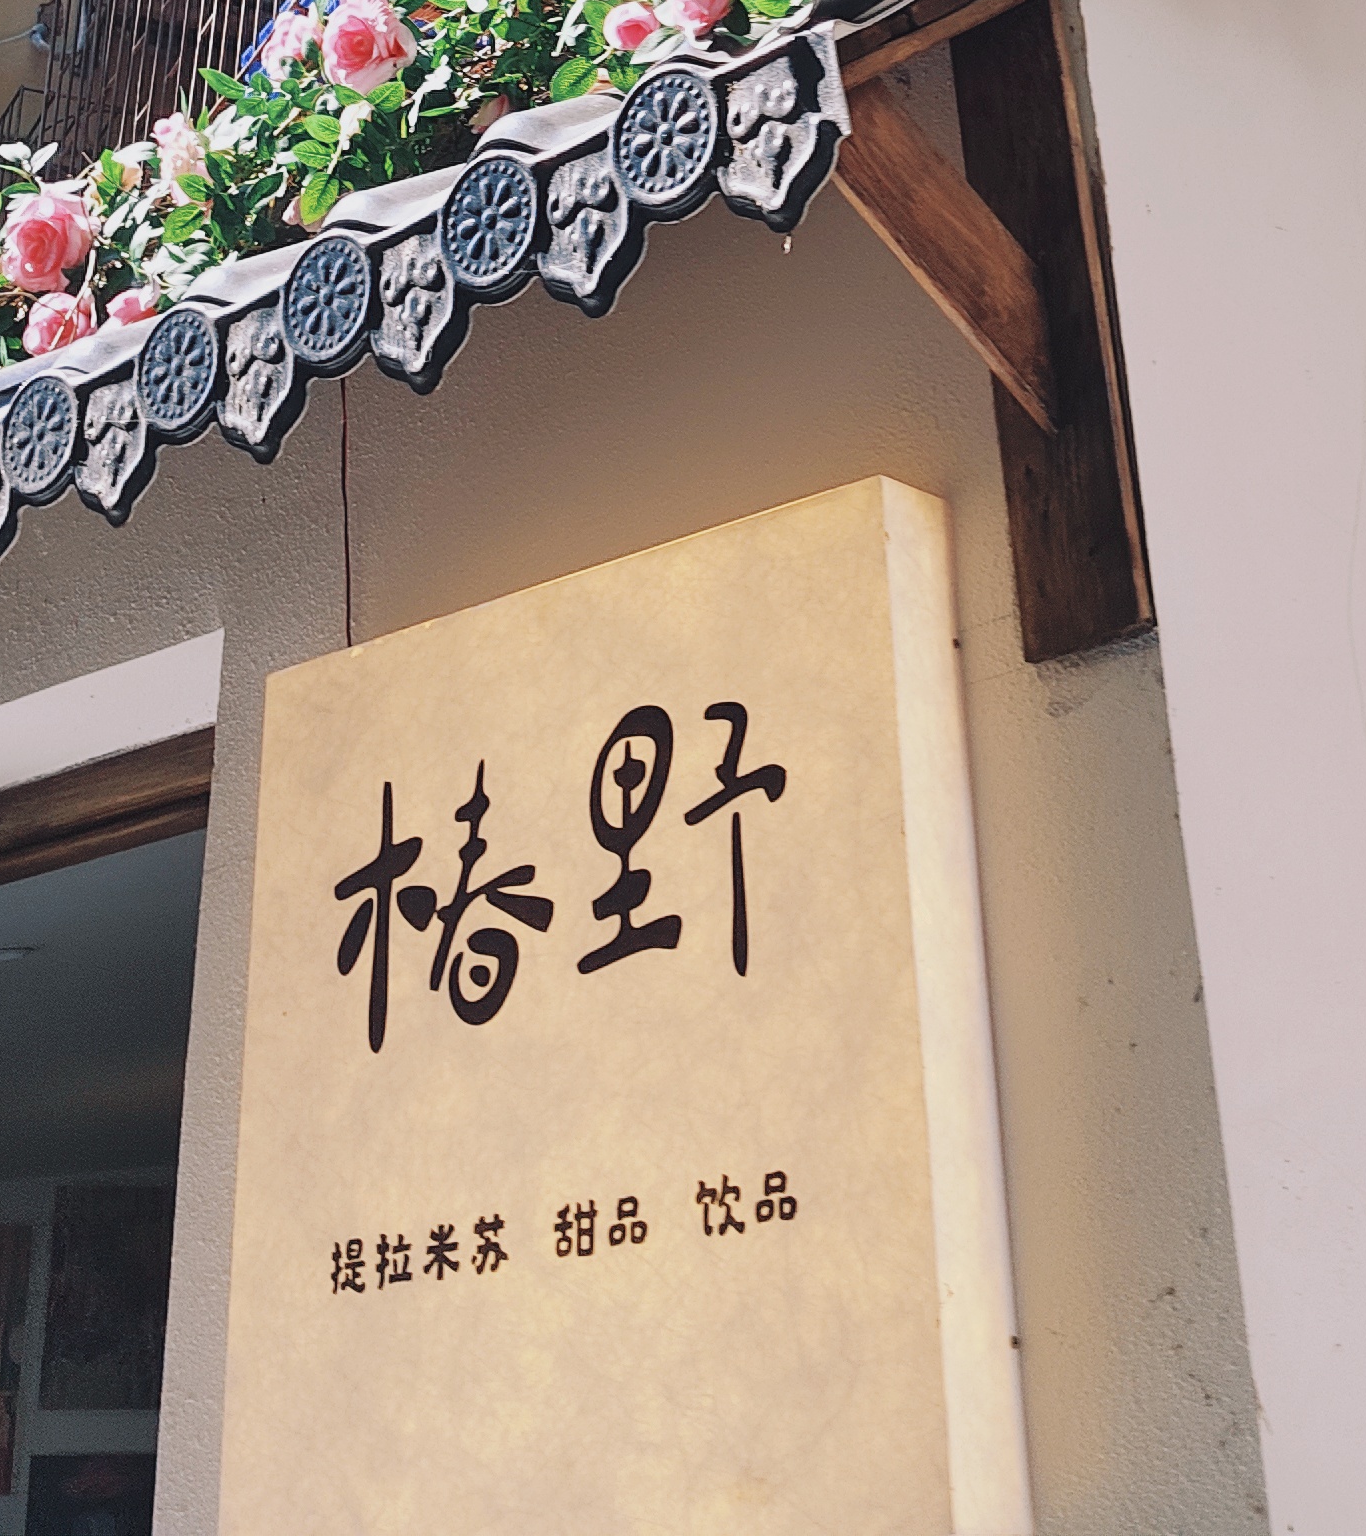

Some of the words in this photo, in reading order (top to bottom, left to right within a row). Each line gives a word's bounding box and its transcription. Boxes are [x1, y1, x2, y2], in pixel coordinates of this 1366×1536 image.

[335, 702, 786, 1053] 椿野
[330, 1214, 509, 1294] 提拉米苏
[554, 1195, 649, 1257] 甜品
[696, 1170, 799, 1237] 饮品
